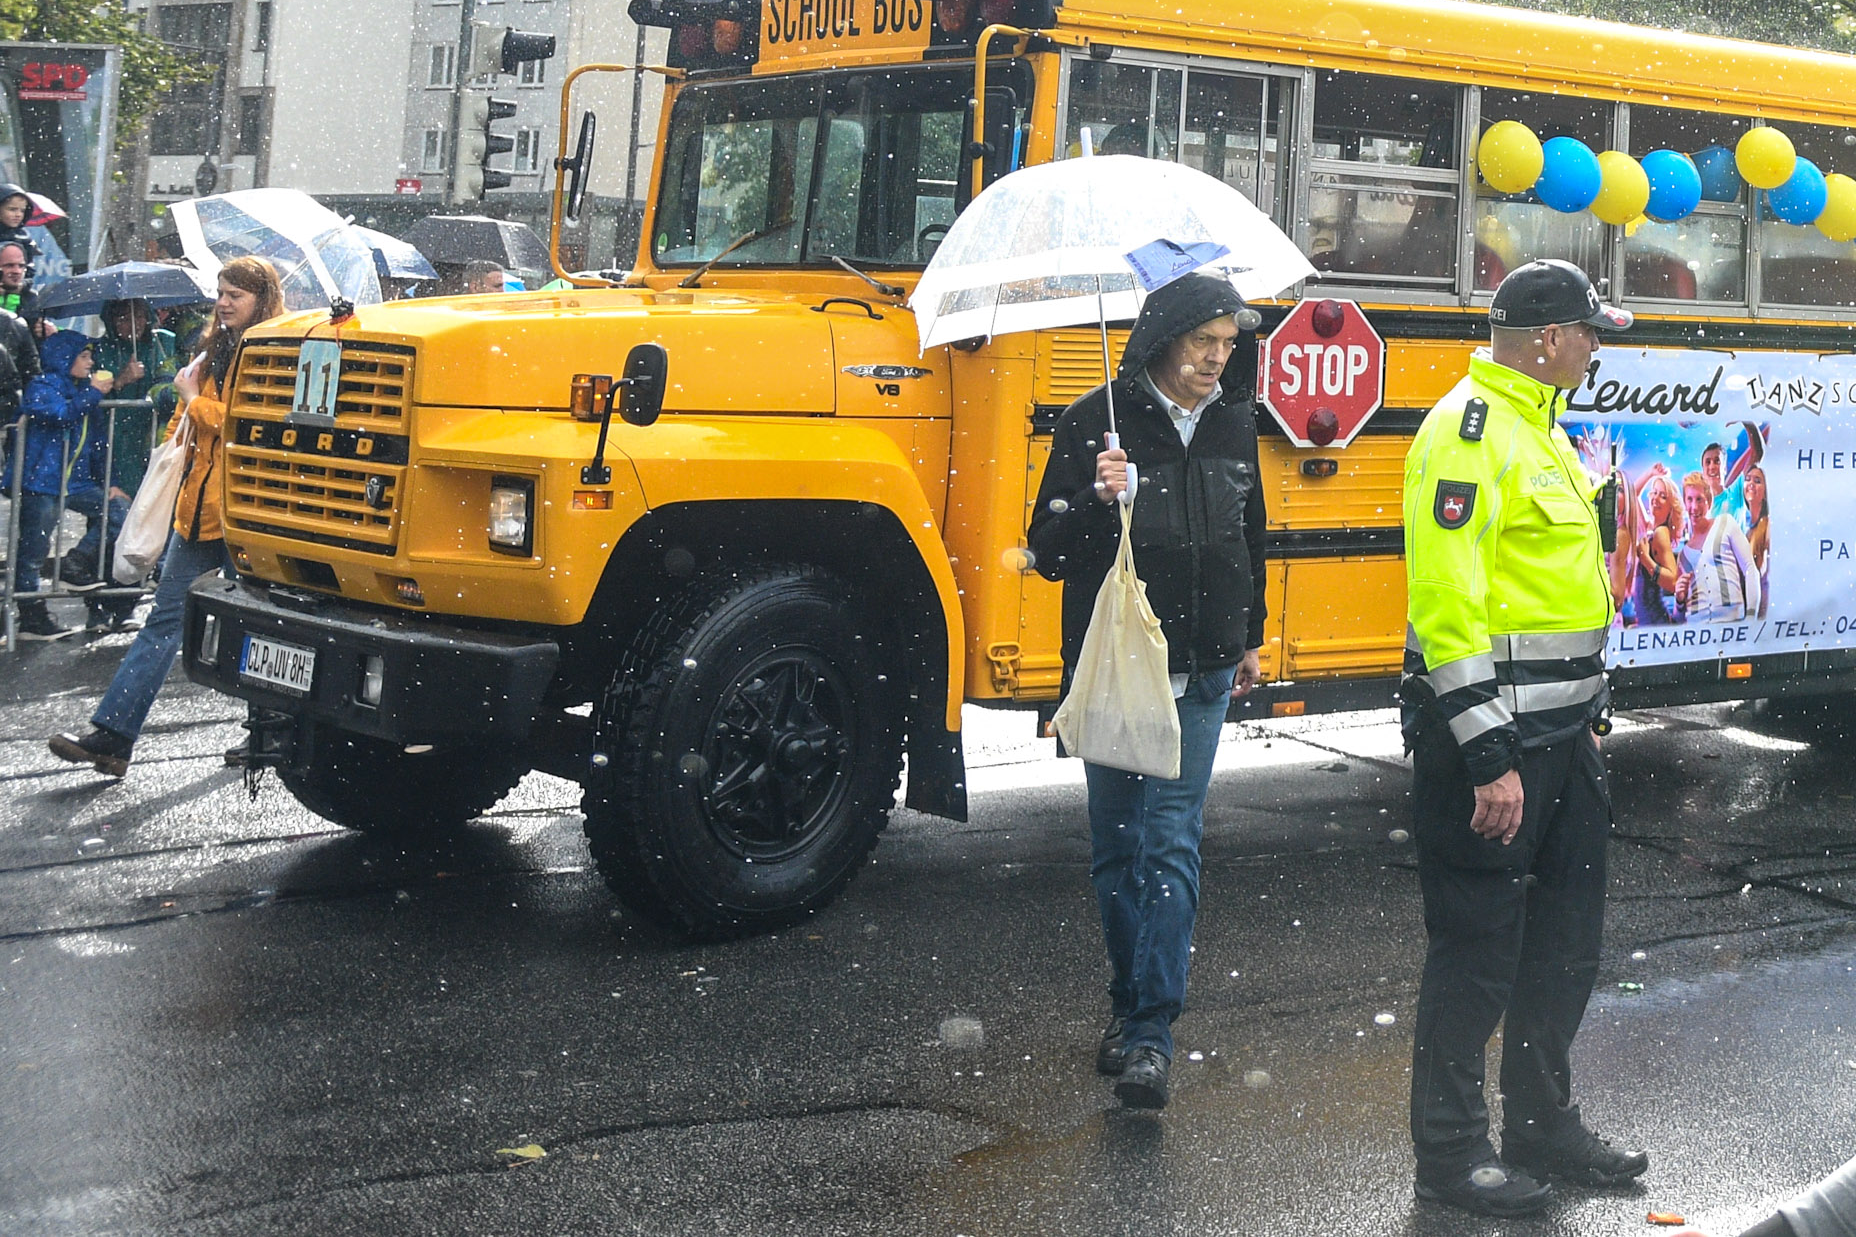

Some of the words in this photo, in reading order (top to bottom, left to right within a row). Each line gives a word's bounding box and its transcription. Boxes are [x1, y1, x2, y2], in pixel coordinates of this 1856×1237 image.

[21, 62, 88, 89] SPD
[297, 360, 332, 414] 11
[875, 383, 900, 396] V8
[1280, 343, 1369, 397] STOP
[1566, 359, 1724, 415] Lenard
[249, 424, 374, 456] FORD
[247, 642, 270, 675] CLP
[273, 648, 290, 680] UV
[289, 653, 306, 686] 8H
